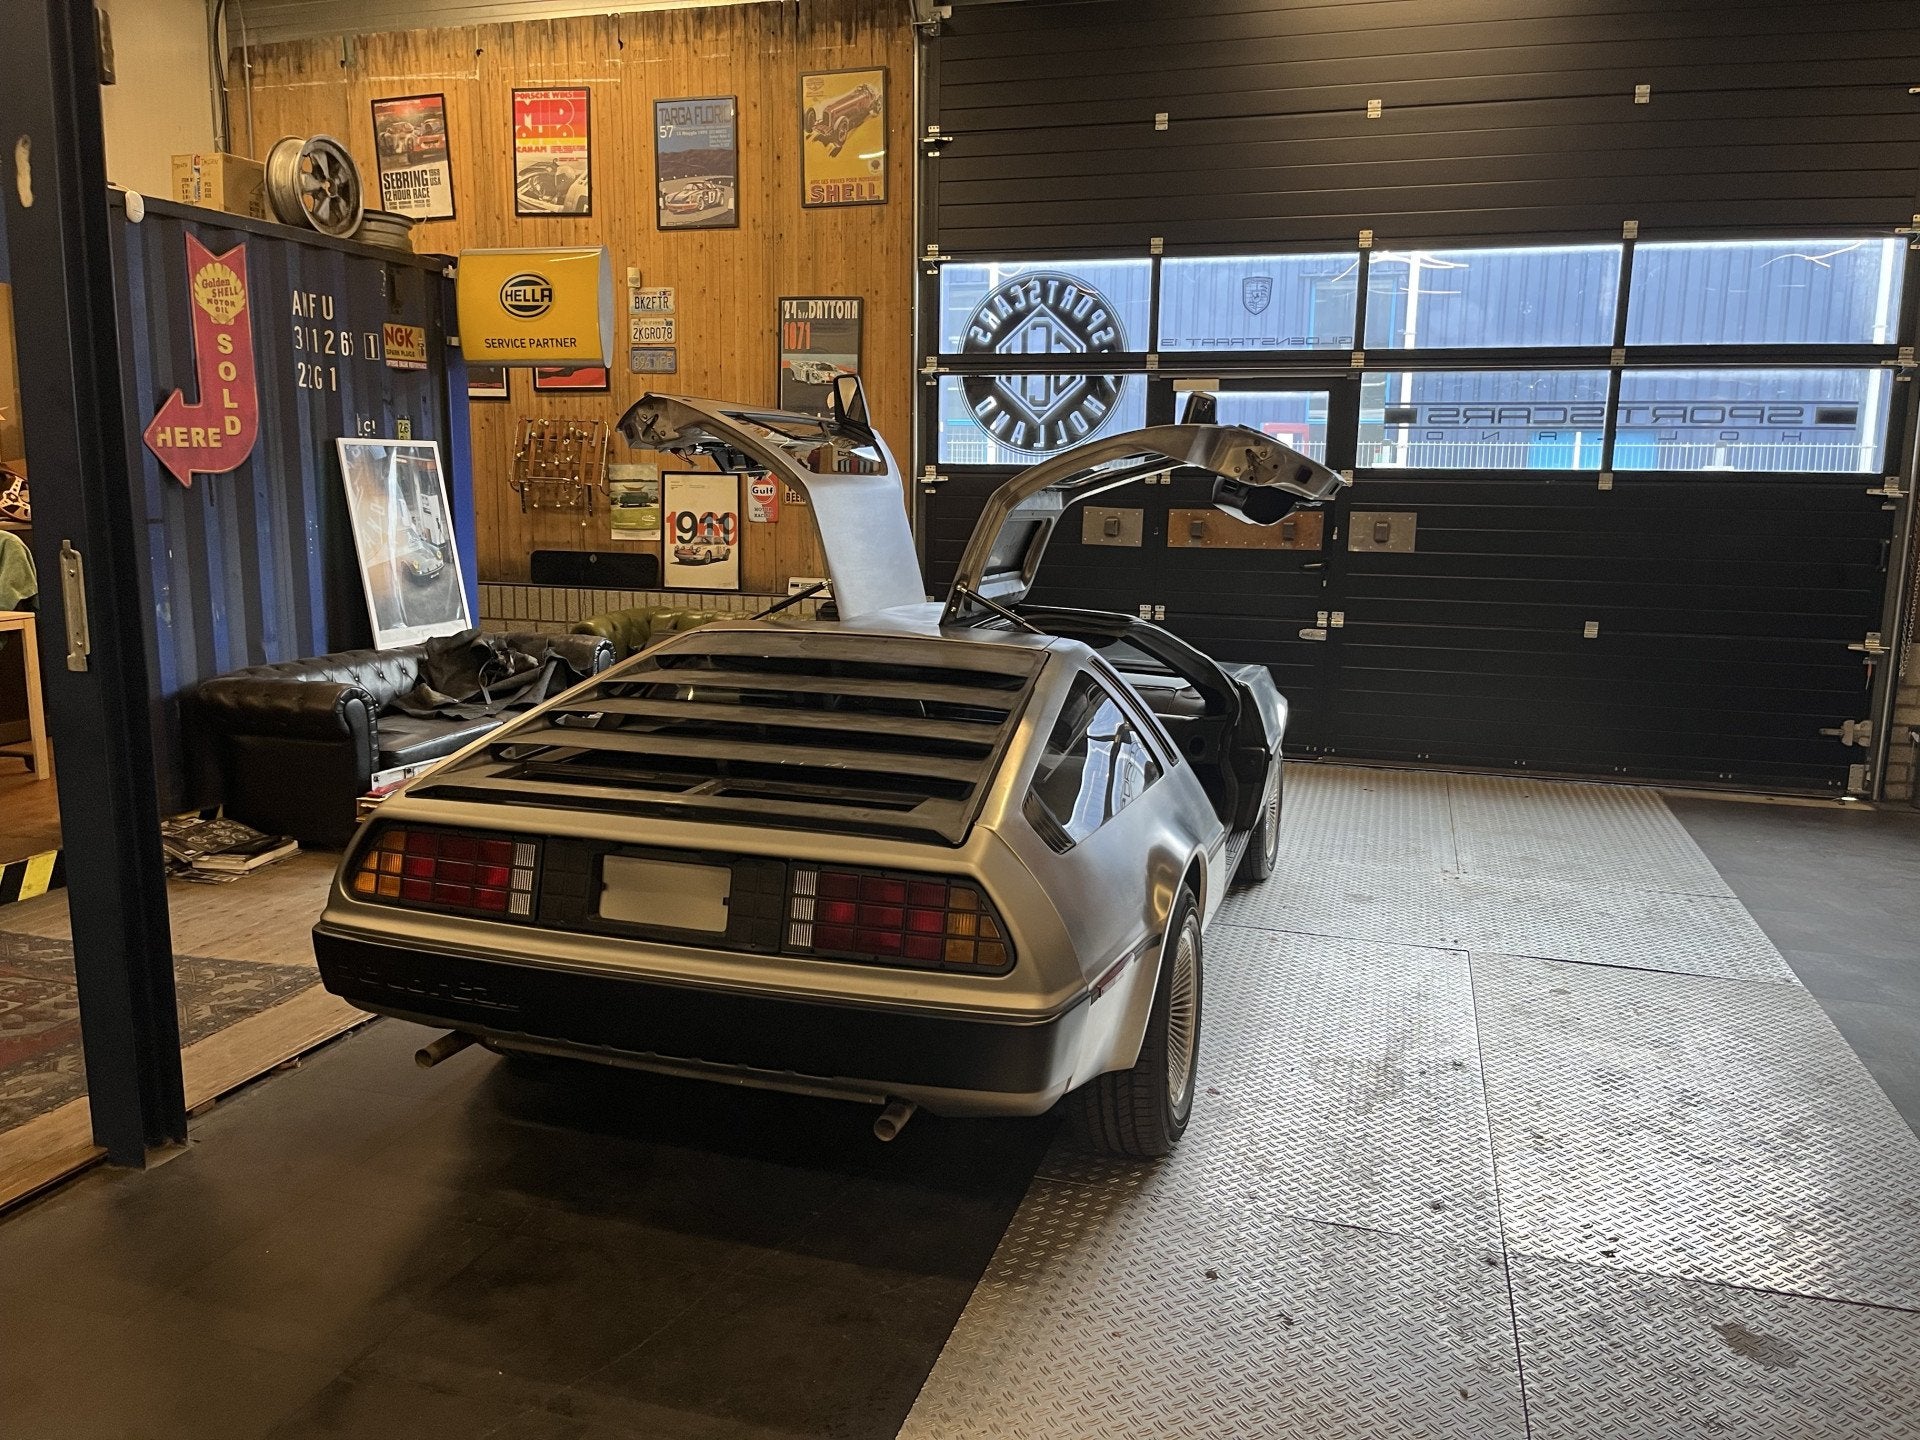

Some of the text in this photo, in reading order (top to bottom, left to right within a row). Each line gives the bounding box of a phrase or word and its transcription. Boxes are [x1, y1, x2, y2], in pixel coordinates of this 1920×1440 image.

[515, 92, 551, 100] PORSCHE
[658, 106, 693, 127] TARGA
[383, 169, 429, 190] SEBRING
[430, 176, 441, 187] USA
[385, 187, 430, 202] 12 HOUR RACE
[810, 181, 881, 203] SHELL
[202, 277, 231, 289] Golden
[212, 286, 239, 298] SHELL
[505, 287, 553, 303] HELLA
[207, 298, 236, 307] MOTOR
[634, 296, 669, 310] BK2FTR
[215, 306, 229, 314] OIL
[784, 301, 797, 319] 24
[808, 301, 858, 319] DAYTONA
[384, 326, 414, 349] NGK
[484, 337, 577, 349] SERVICE PARTNER
[217, 333, 242, 436] SOLD
[156, 426, 222, 448] HERE
[752, 486, 774, 495] Gulf
